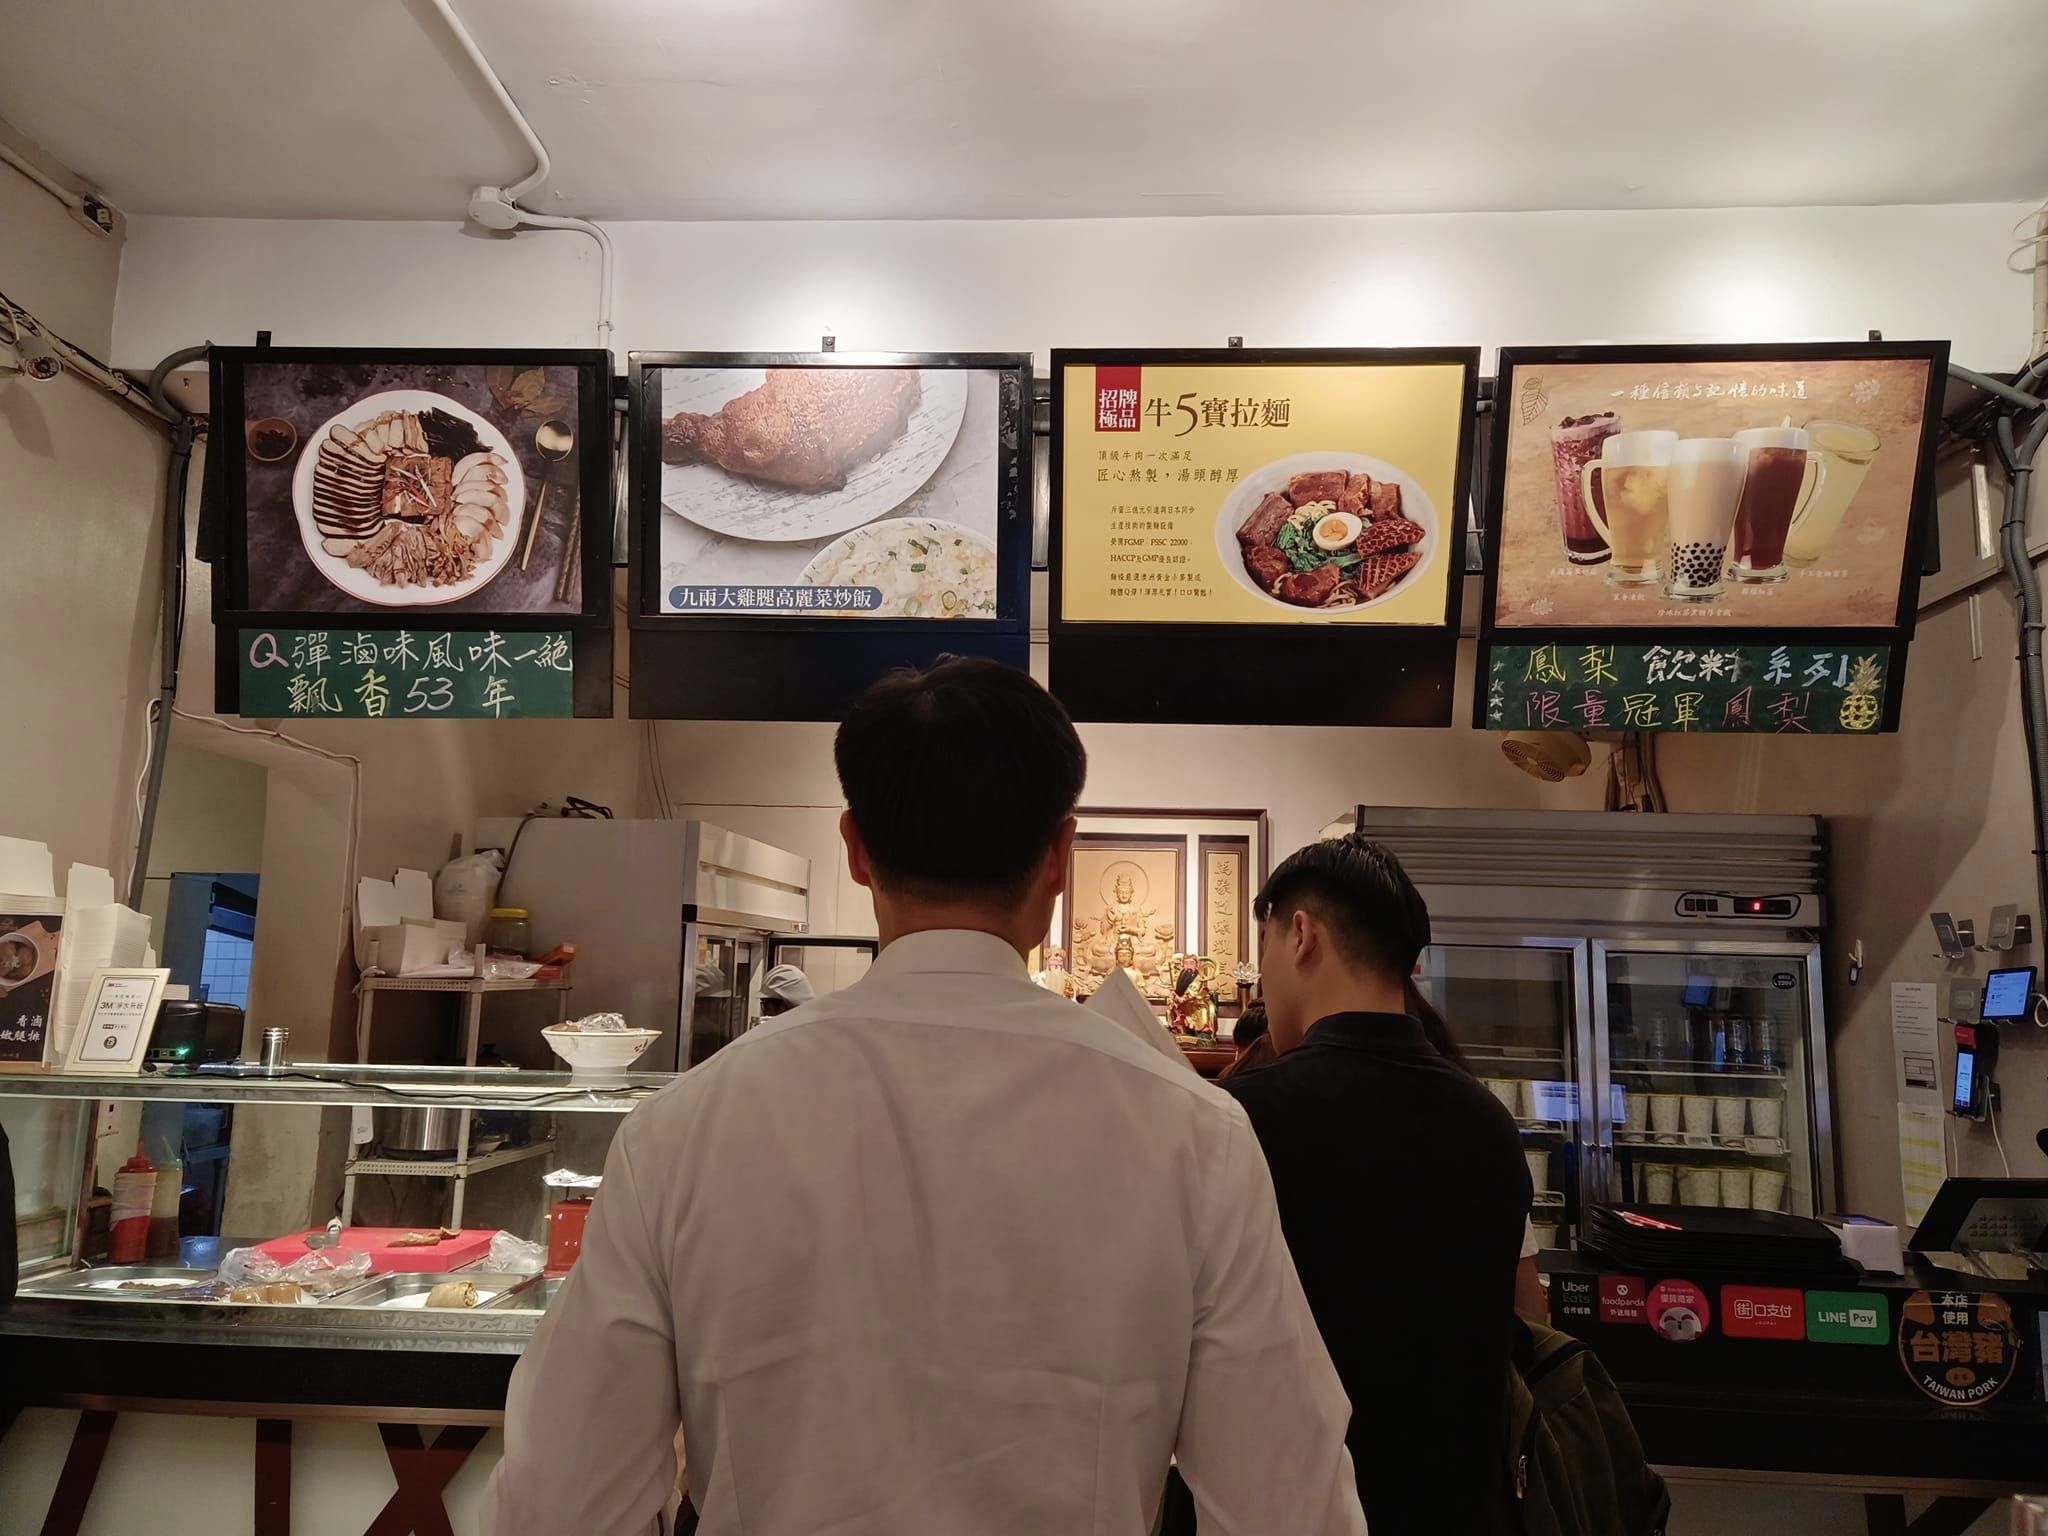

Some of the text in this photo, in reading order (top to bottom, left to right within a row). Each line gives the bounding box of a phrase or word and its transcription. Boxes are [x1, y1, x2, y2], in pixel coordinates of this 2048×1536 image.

[1098, 389, 1138, 409] 招牌
[1098, 409, 1137, 429] 極品
[1144, 392, 1290, 437] 牛5寶拉麵
[1098, 450, 1193, 462] 頂級牛肉一次滿足
[679, 587, 873, 609] 九兩大雞腿高麗菜炒飯
[1562, 1280, 1589, 1293] Uber
[1563, 1293, 1590, 1304] Eats
[1601, 1296, 1645, 1307] foodpanda
[1942, 1294, 1968, 1308] 本店
[1734, 1299, 1793, 1320] 街口支付
[1818, 1311, 1874, 1326] LINE Pay
[1942, 1311, 1968, 1325] 使用
[1923, 1375, 1998, 1400] TAIWAN PORK
